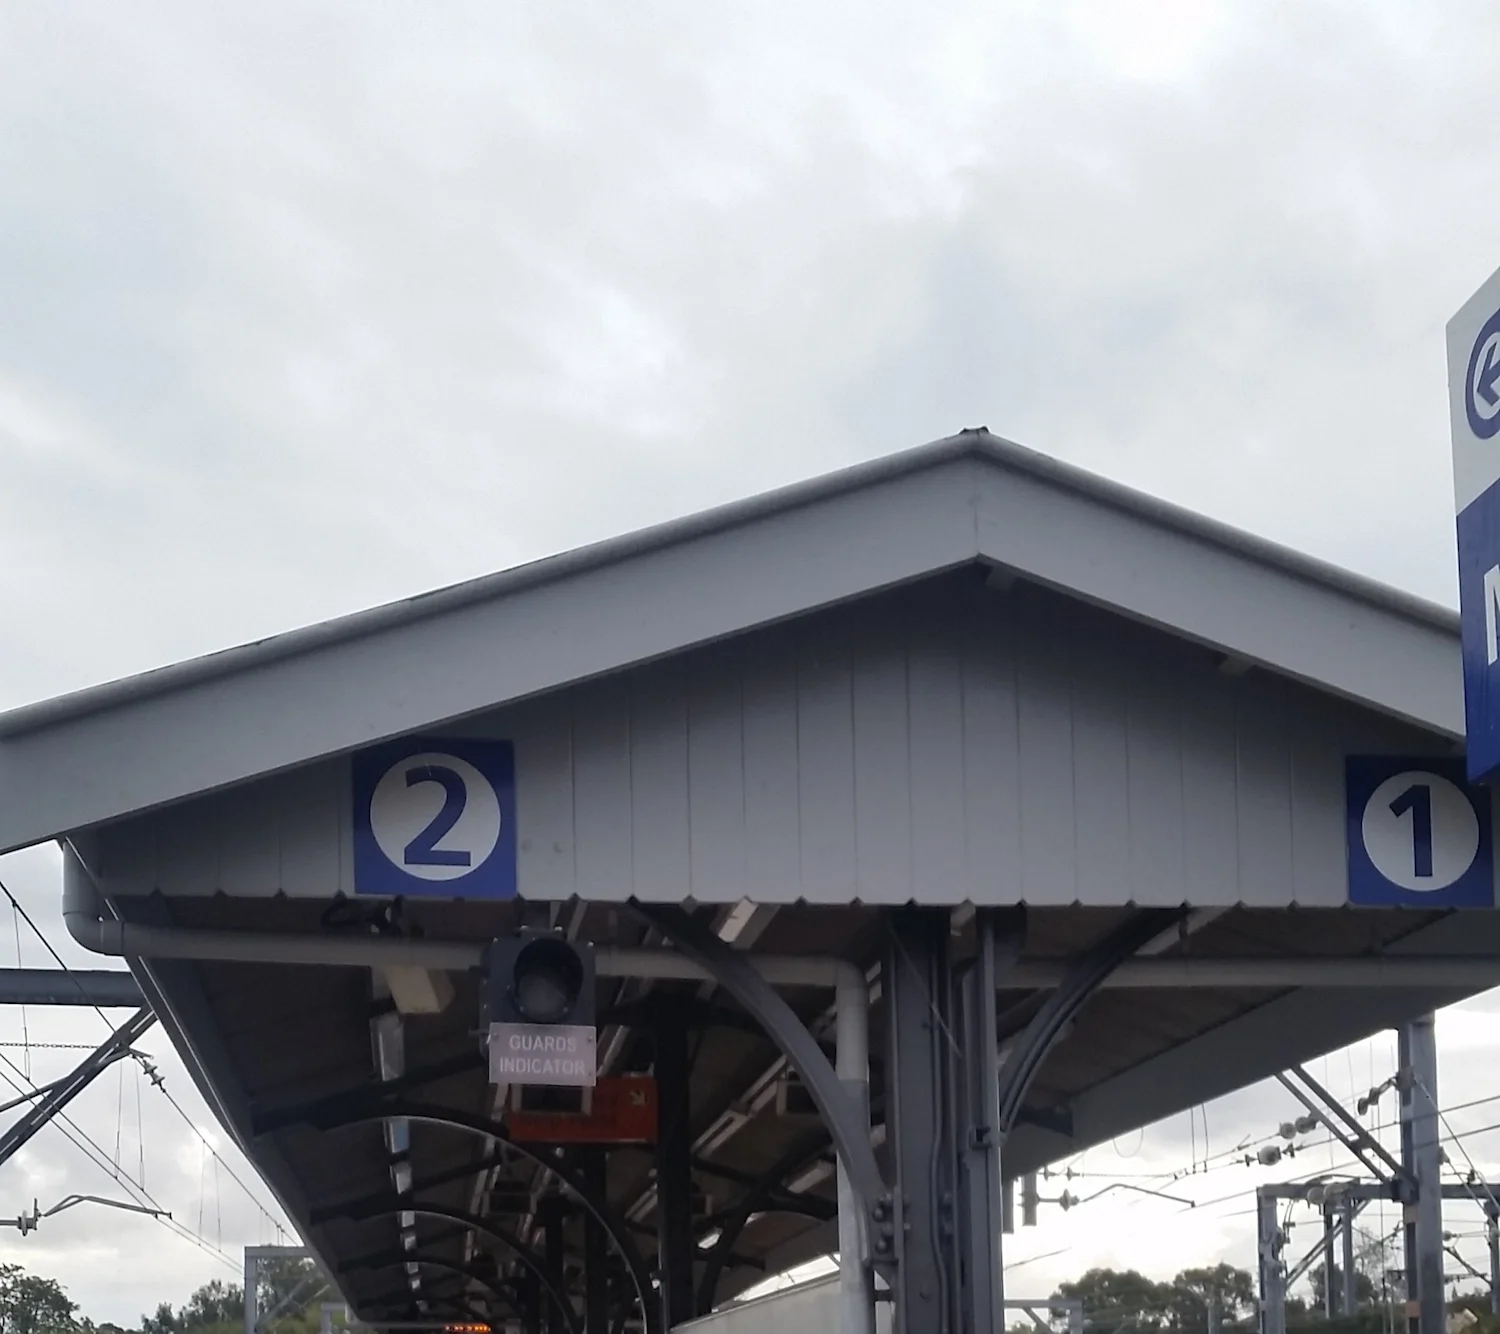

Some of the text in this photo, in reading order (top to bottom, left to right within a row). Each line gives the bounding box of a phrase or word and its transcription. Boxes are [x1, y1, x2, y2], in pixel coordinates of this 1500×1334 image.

[404, 765, 471, 867] 2
[1389, 784, 1433, 877] 1
[500, 1056, 586, 1077] INDICATOR
[508, 1034, 577, 1053] GUARDS
